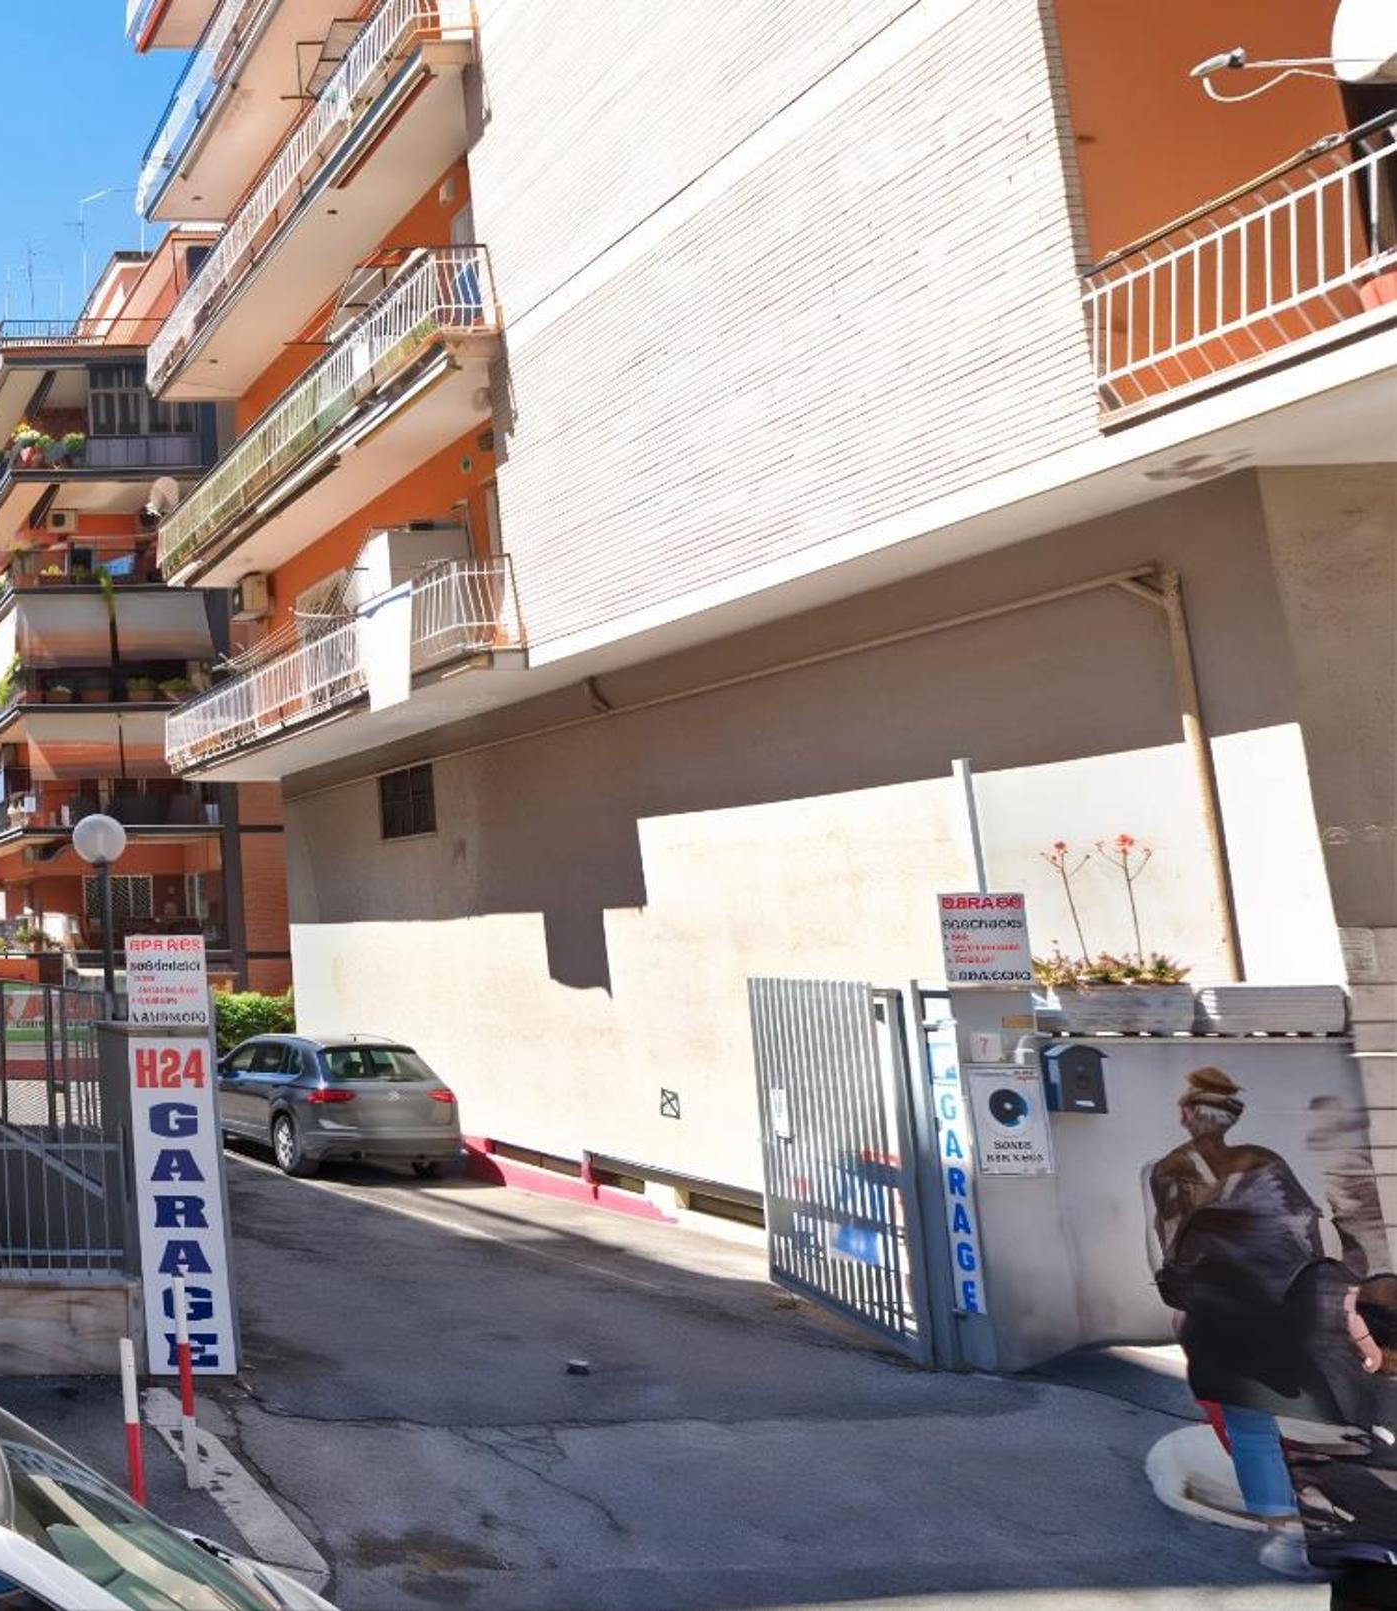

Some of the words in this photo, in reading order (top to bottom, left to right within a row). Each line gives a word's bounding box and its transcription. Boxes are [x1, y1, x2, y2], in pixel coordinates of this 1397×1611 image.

[135, 1048, 205, 1089] H24
[978, 1037, 988, 1056] 7
[149, 1102, 219, 1368] GARAGE
[939, 1093, 978, 1314] GARAGE
